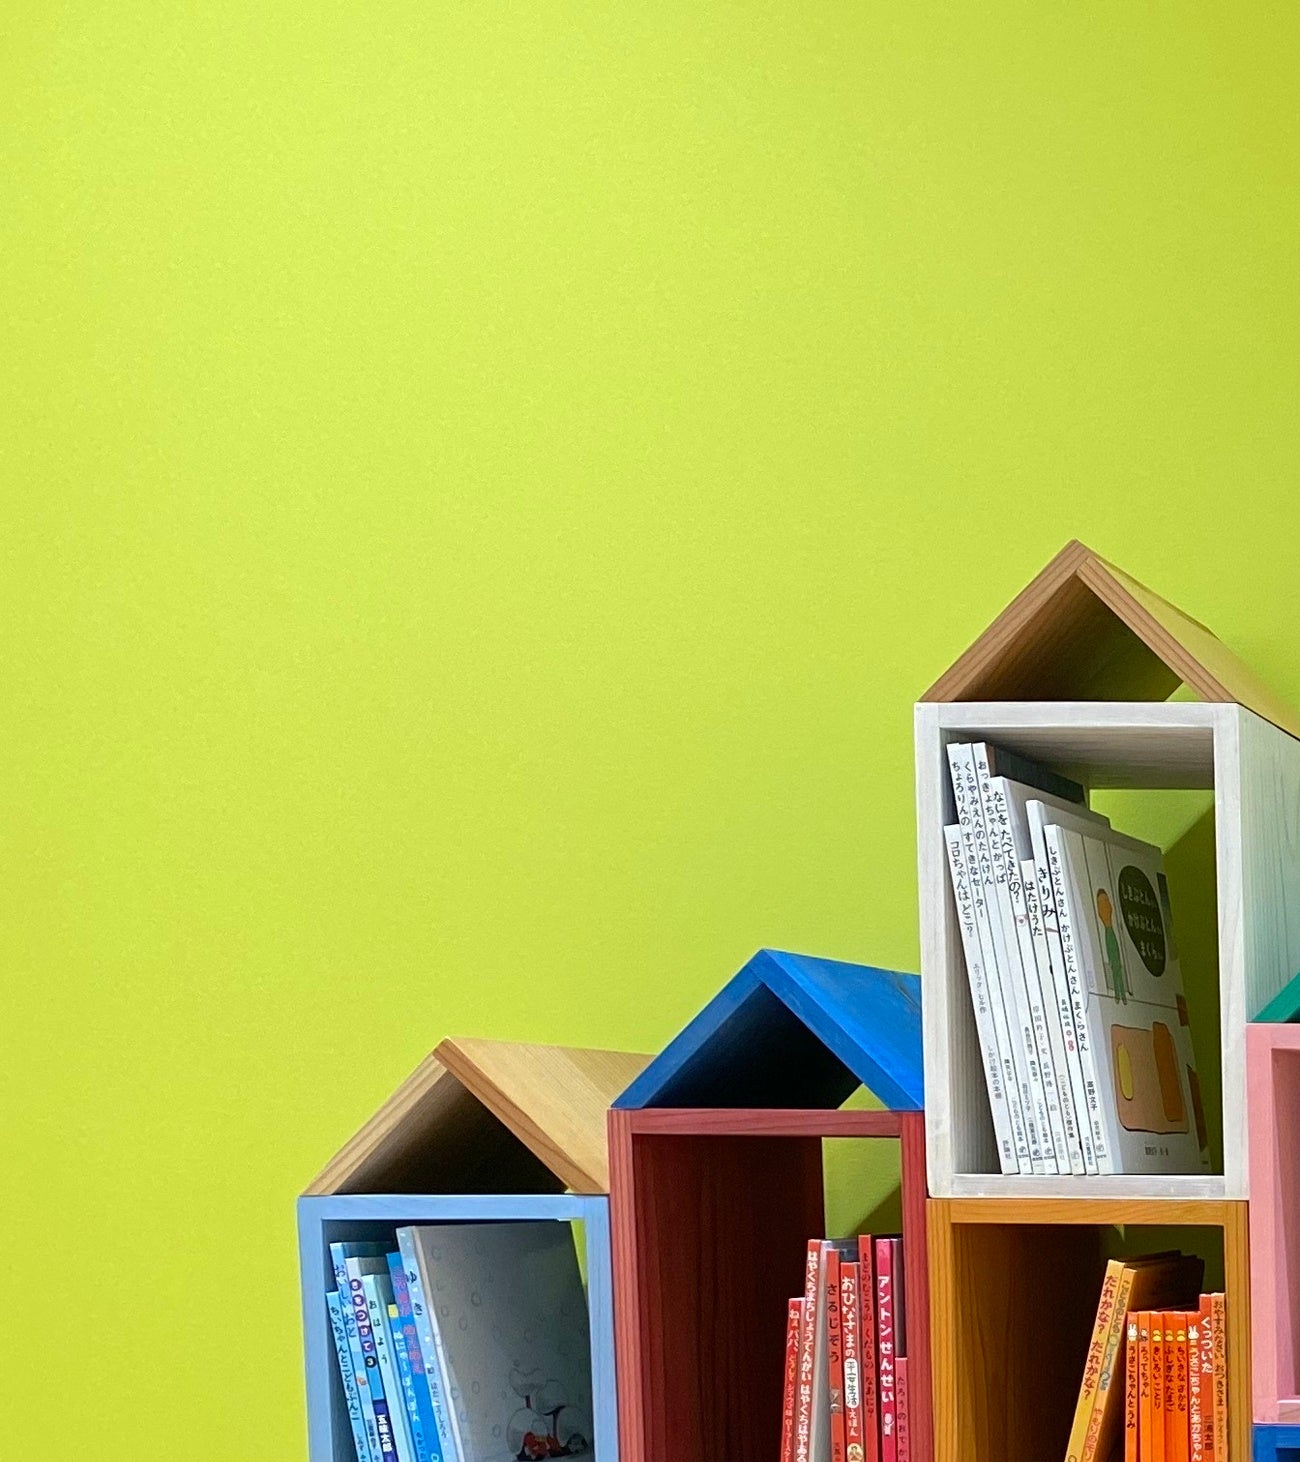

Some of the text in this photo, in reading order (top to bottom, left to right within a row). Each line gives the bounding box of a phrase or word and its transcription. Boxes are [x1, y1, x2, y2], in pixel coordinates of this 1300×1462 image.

[964, 761, 994, 886] くらやみえんのたんけん
[977, 761, 1006, 885] おっきょちゃんとかっぱ
[993, 791, 1008, 825] なにを
[951, 761, 984, 918] ちょろりんの すてきなセーター
[949, 841, 971, 901] コロちゃんは
[1037, 866, 1058, 918] きりみ
[1024, 880, 1043, 937] はたけうた
[1048, 846, 1090, 1053] しきぶとんさん かけぶとんさん まくらさん
[801, 1250, 818, 1380] はやくちまちしょうてんがい
[826, 1283, 840, 1363] さるじぞう
[1097, 1275, 1119, 1335] だれかな?
[1213, 1301, 1225, 1360] おやすみなさい
[878, 1275, 894, 1403] アントンせんせい
[1201, 1316, 1213, 1373] くっついた
[1083, 1340, 1105, 1400] だれかな?
[1126, 1346, 1137, 1430] うさこちゃんとうみ
[1214, 1364, 1226, 1407] おつきさま
